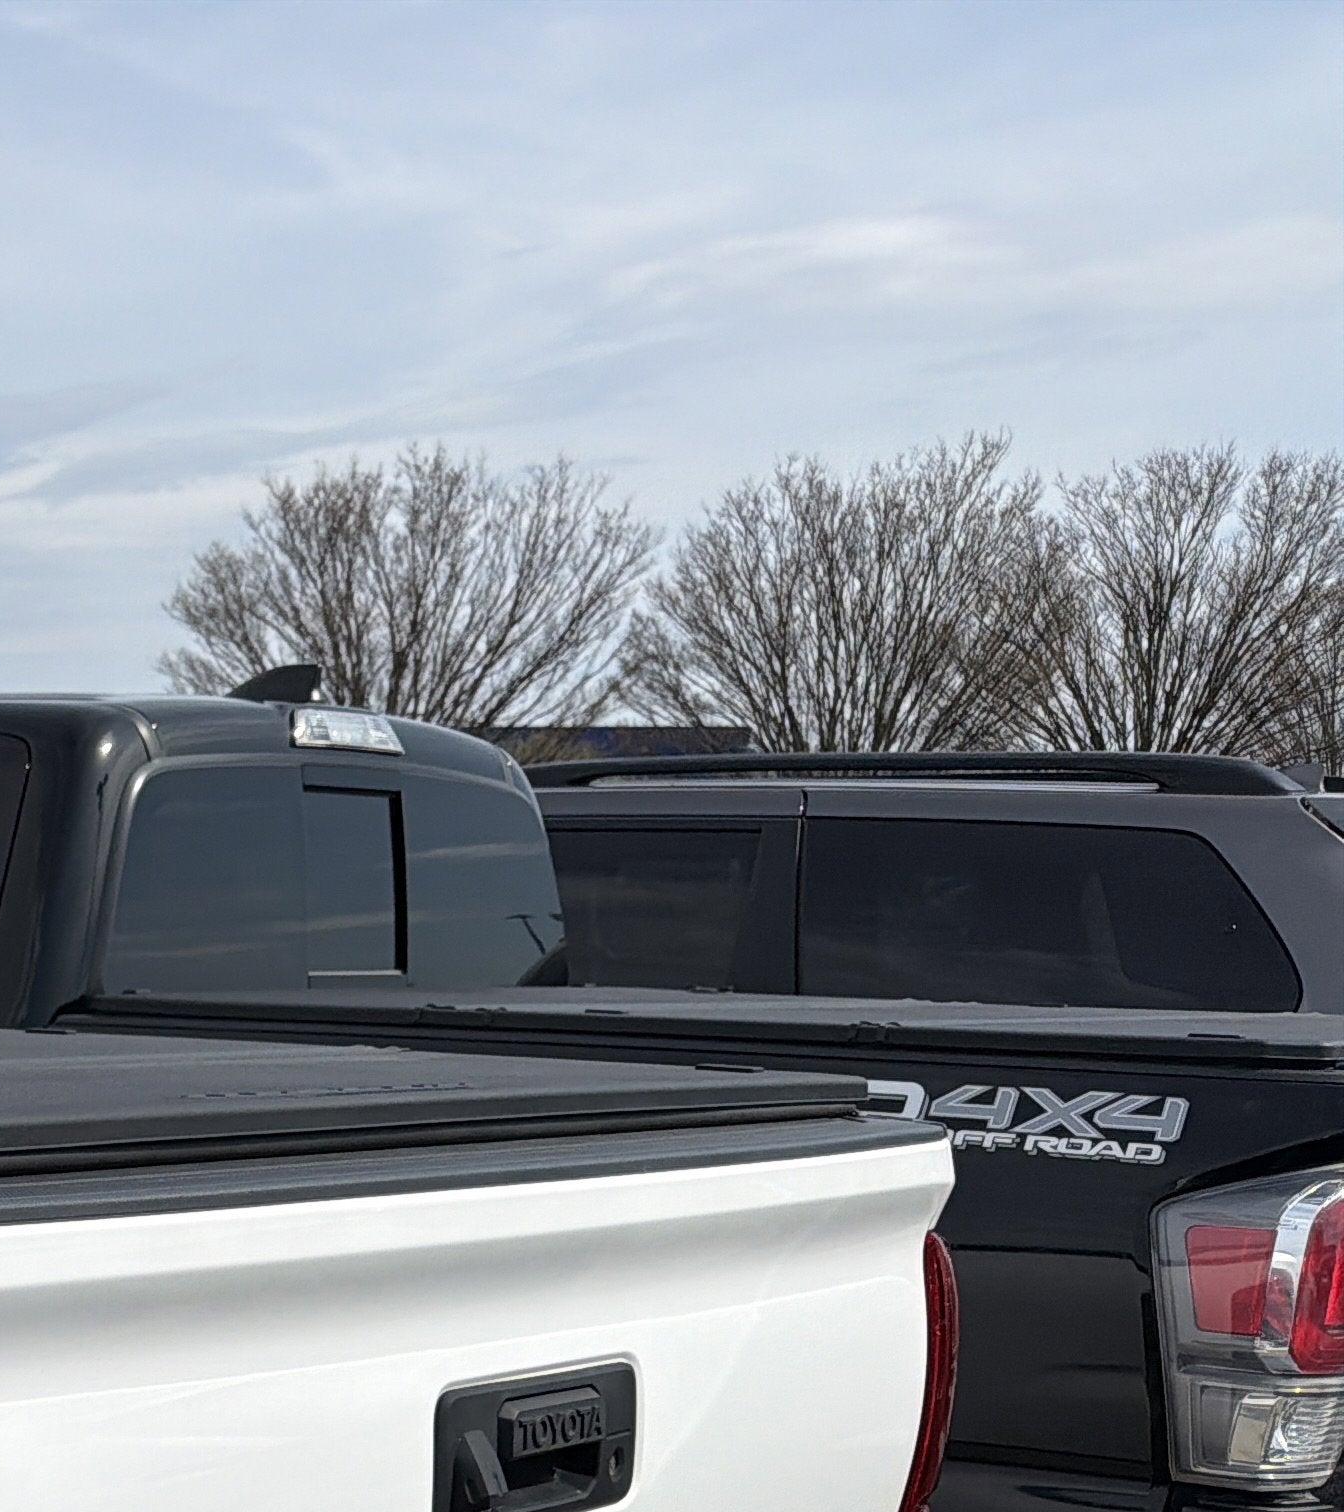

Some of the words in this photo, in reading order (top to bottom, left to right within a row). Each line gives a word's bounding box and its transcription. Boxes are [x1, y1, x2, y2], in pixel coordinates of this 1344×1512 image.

[929, 1084, 1190, 1142] 4X4
[947, 1129, 1018, 1150] FF
[1023, 1135, 1164, 1164] ROAD
[518, 1405, 602, 1451] TOYOTA
